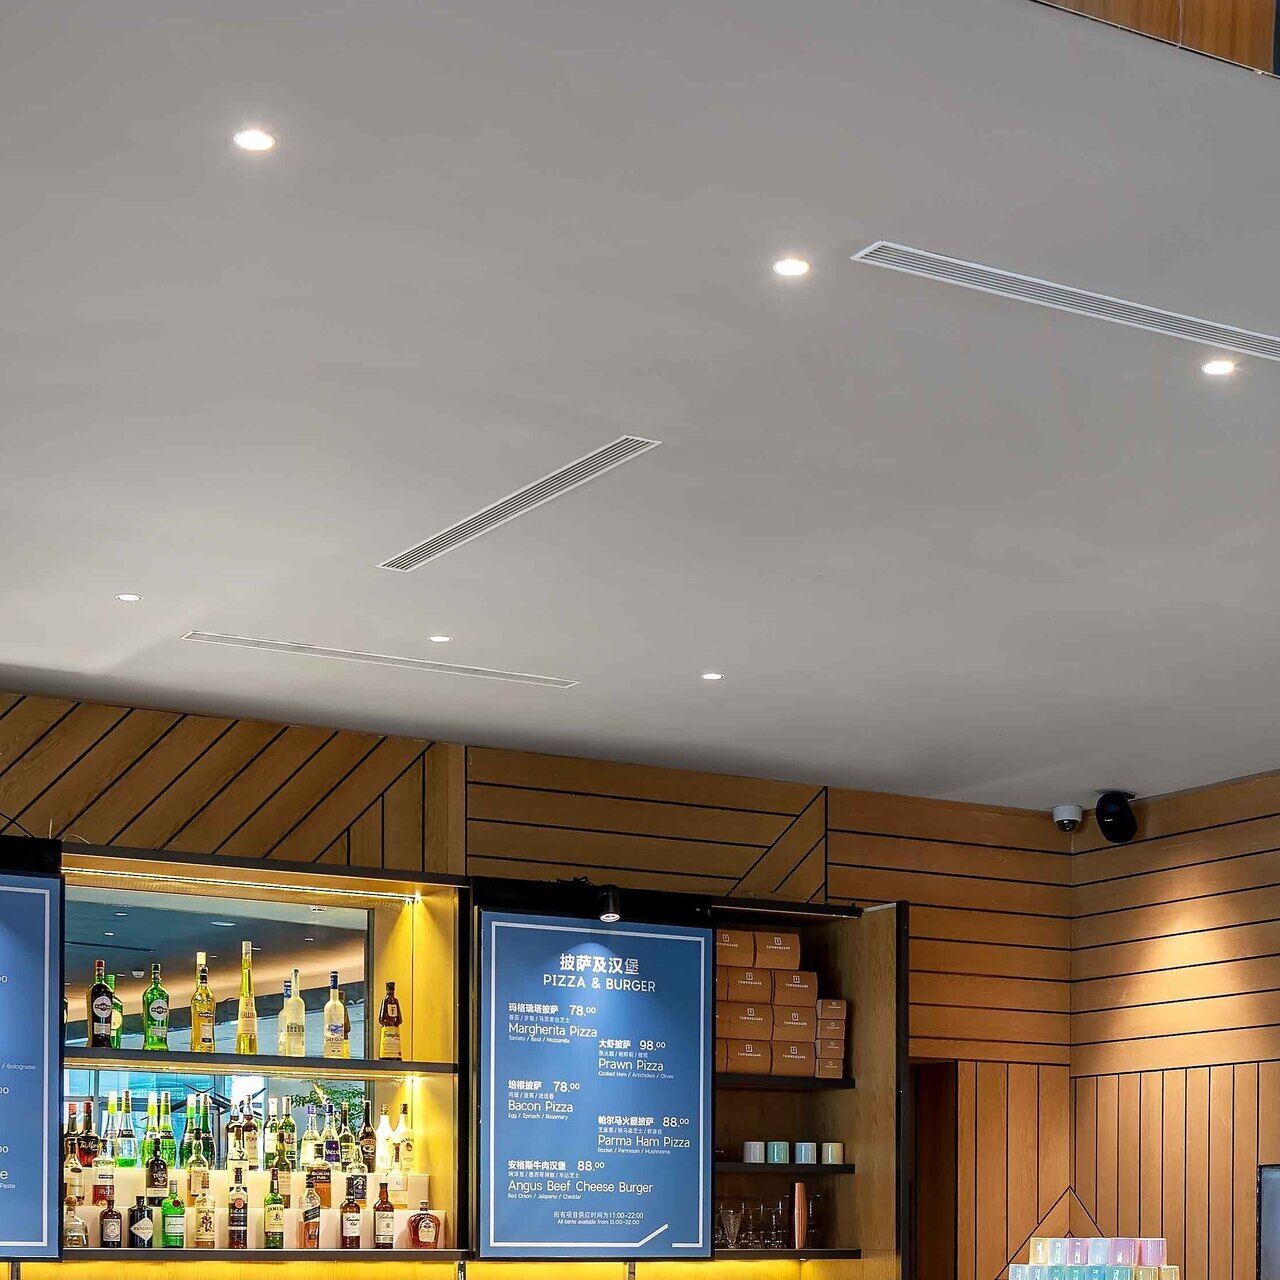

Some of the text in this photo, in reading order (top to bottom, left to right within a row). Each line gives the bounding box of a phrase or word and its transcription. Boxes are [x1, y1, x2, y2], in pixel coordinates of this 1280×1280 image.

[559, 952, 640, 975] 披萨及汉堡
[543, 973, 656, 992] PIZZA & BURGER
[508, 1022, 598, 1038] Margherita Pizza
[598, 1058, 664, 1072] Prawn Pizza
[508, 1100, 574, 1113] Bacon Pizza
[598, 1135, 690, 1148] Parma Ham Pizza
[508, 1180, 654, 1196] Angus Beef Cheese Burger
